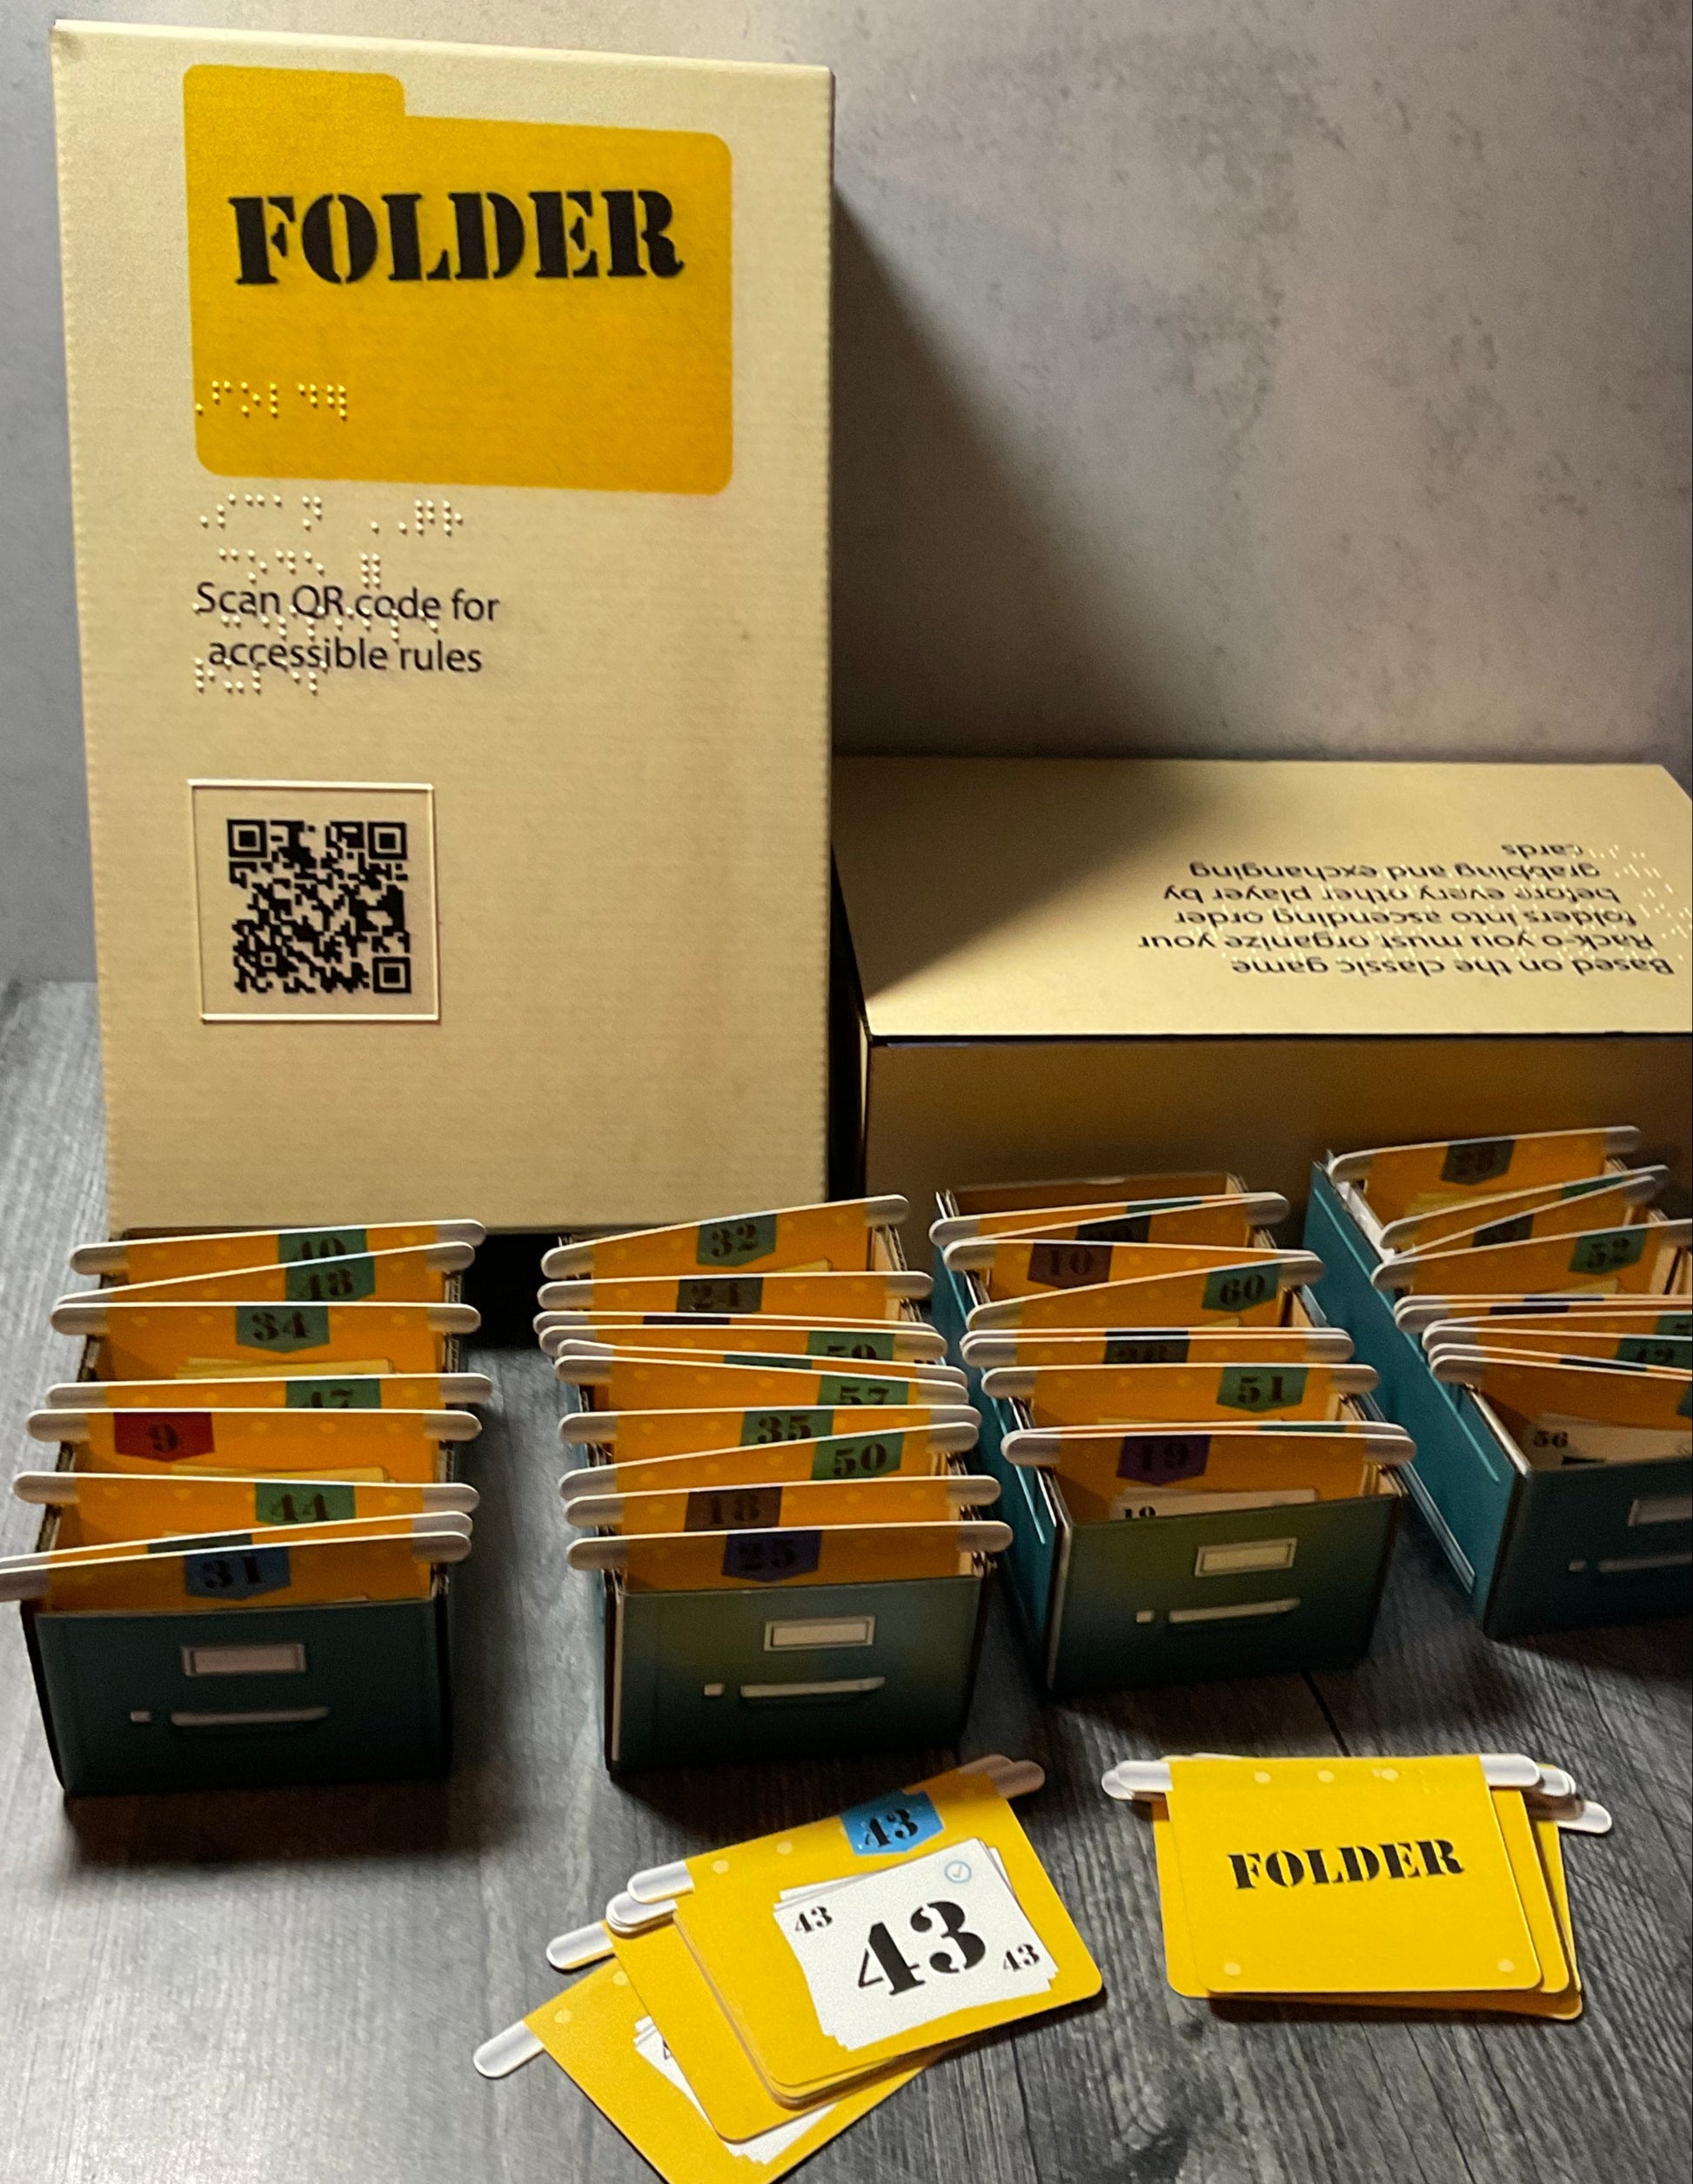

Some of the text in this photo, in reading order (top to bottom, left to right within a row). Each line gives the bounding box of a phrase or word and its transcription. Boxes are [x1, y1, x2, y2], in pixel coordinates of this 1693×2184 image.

[226, 188, 686, 285] FOLDER
[196, 581, 500, 621] Scan QR code for
[208, 636, 484, 673] accessible rules
[1500, 843, 1584, 860] cards
[1188, 861, 1601, 882] grabbing and exchanging
[1162, 884, 1621, 905] before every other player by
[1175, 908, 1637, 928] folders into ascending order
[1138, 932, 1217, 948] your
[1224, 931, 1369, 952] organize
[1380, 932, 1463, 949] must
[1470, 931, 1536, 948] you
[1231, 957, 1675, 977] Based on the classic game
[710, 1223, 759, 1258] 32
[1219, 1272, 1267, 1305] 60
[251, 1310, 314, 1343] 34
[839, 1384, 890, 1405] 57
[1236, 1374, 1284, 1404] 51
[146, 1421, 179, 1454] 9
[756, 1414, 813, 1444] 35
[833, 1441, 888, 1477] 50
[1141, 1440, 1191, 1471] 19
[200, 1555, 263, 1590] 31
[865, 1807, 920, 1849] 43
[1227, 1838, 1465, 1890] FOLDER
[794, 1905, 833, 1934] 43
[856, 1899, 987, 1997] 43
[1002, 1943, 1041, 1973] 43
